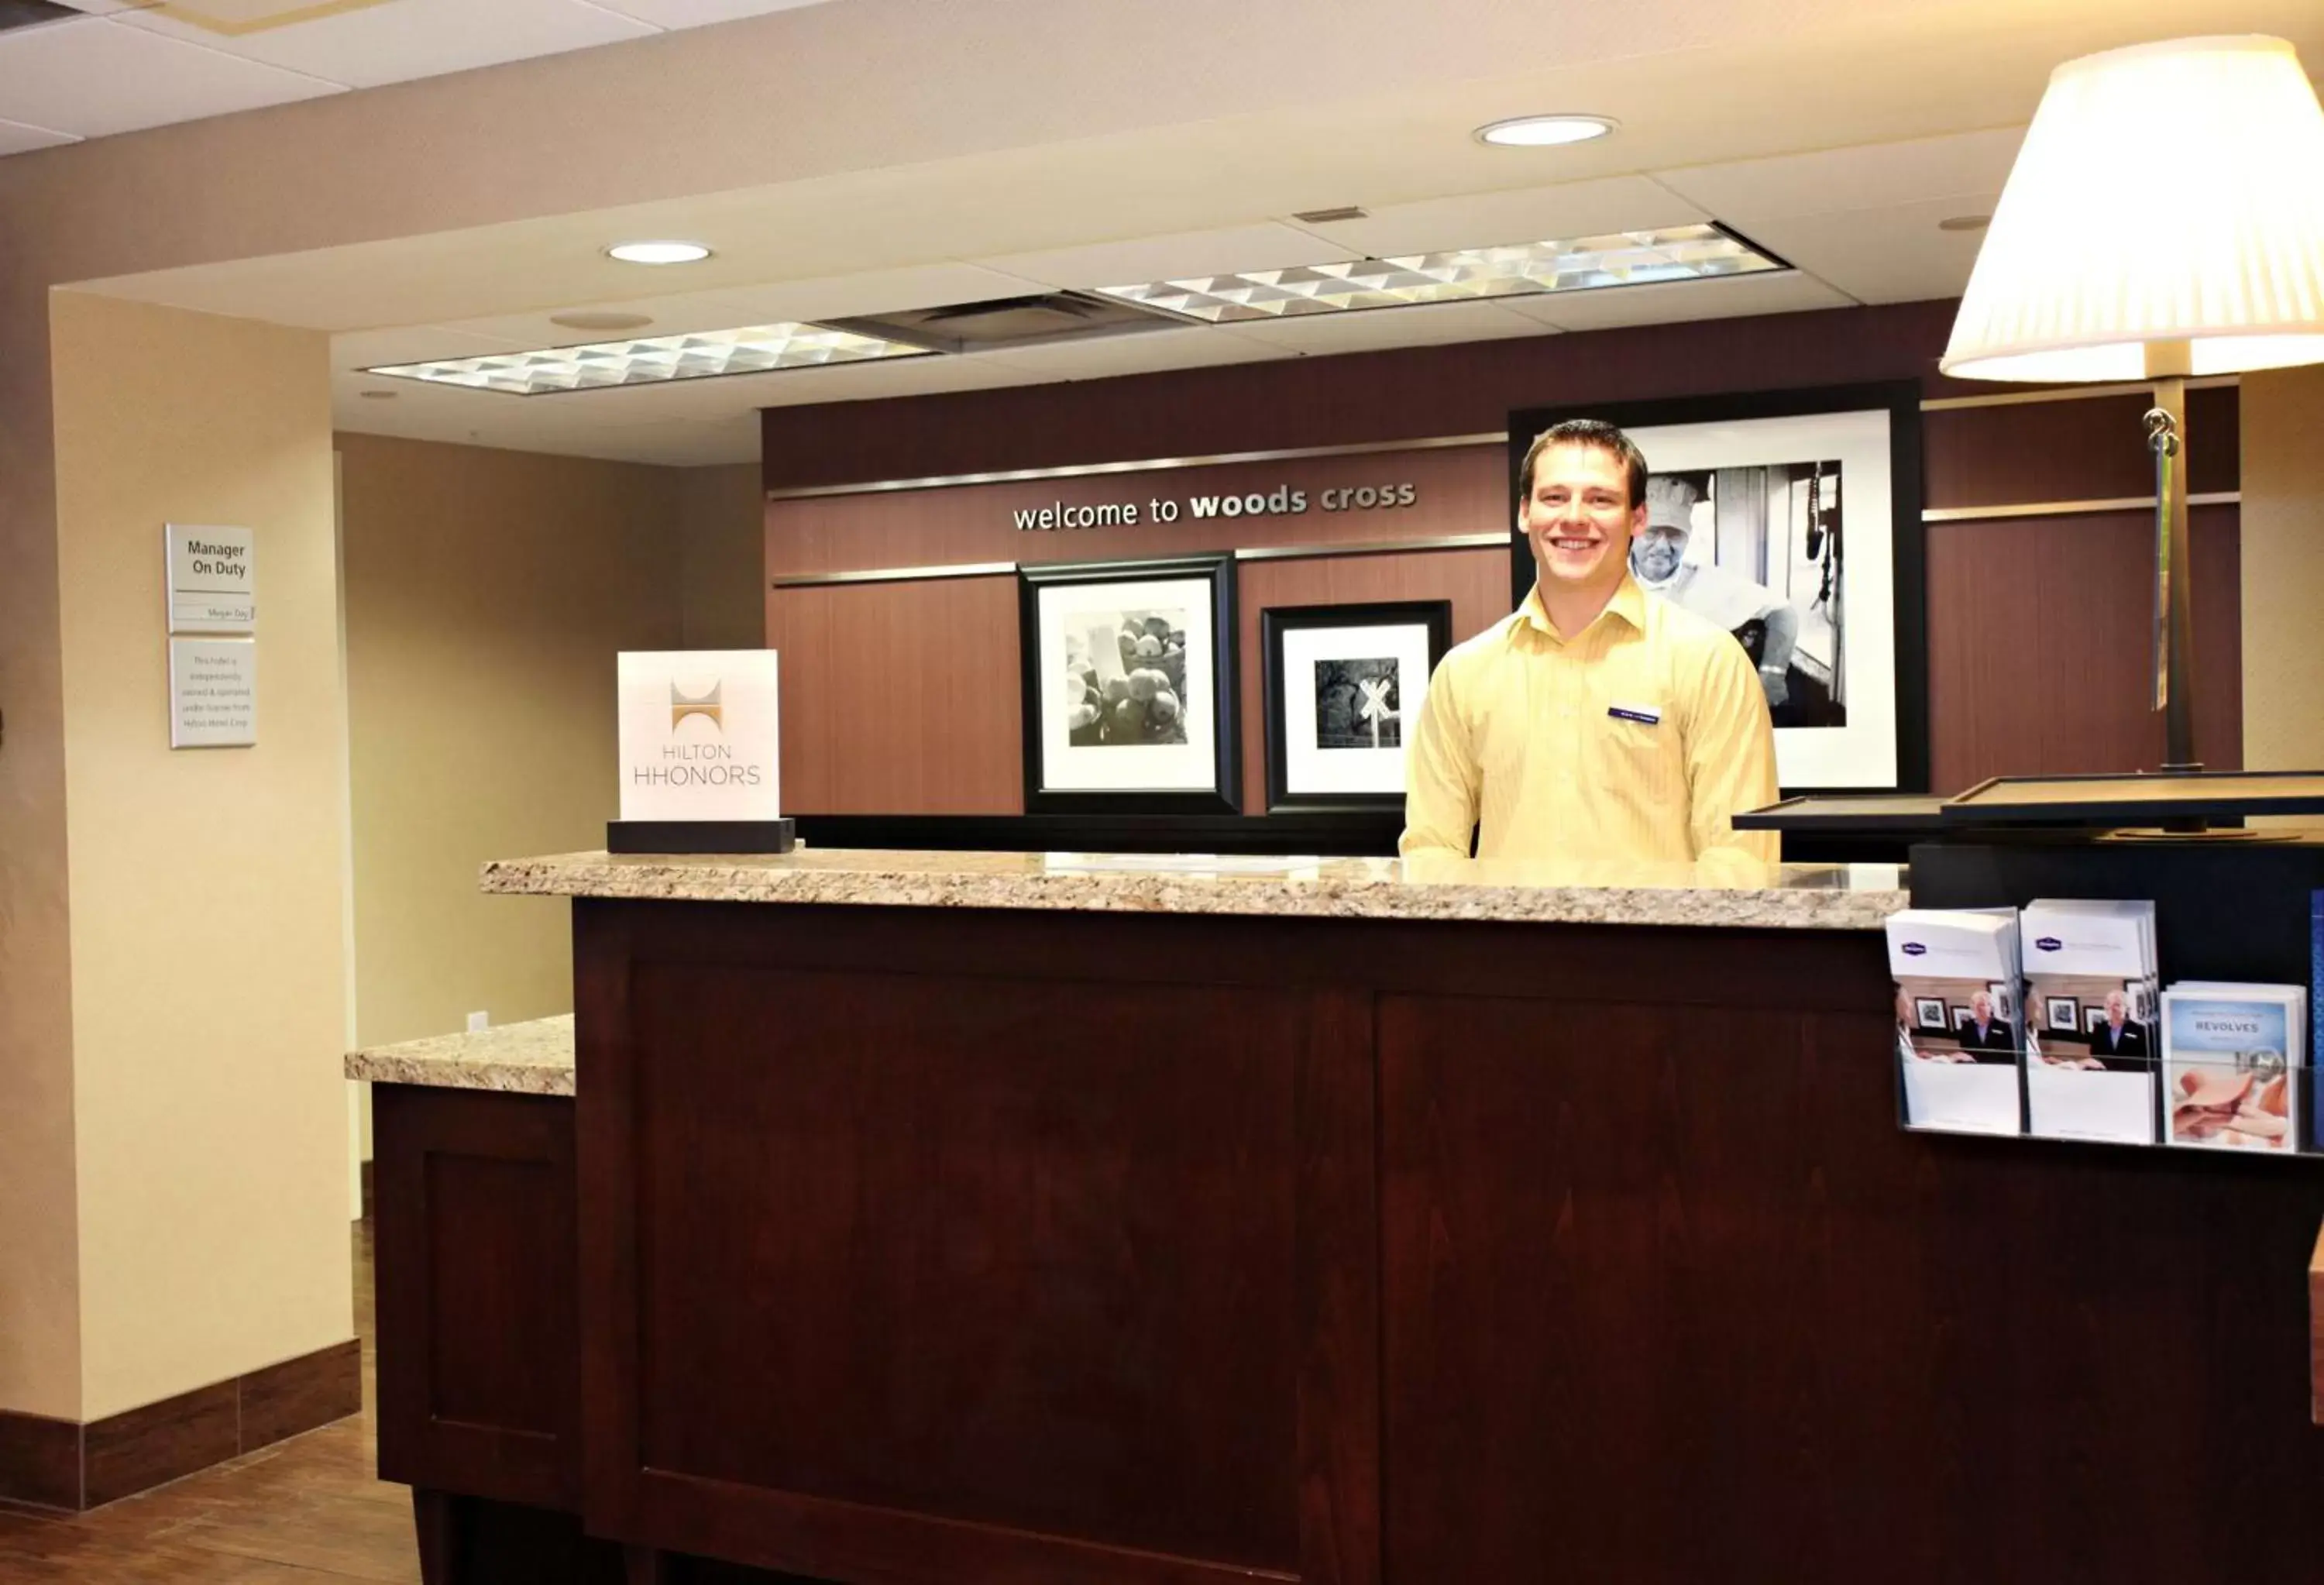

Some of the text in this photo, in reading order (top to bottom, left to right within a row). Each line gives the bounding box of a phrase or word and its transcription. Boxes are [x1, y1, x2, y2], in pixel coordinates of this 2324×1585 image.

[1014, 482, 1416, 530] welcome to woods cross
[187, 540, 245, 559] Manager
[193, 559, 246, 579] On Duty
[662, 744, 731, 760] HILTON
[634, 765, 761, 786] HHONORS
[2195, 1021, 2259, 1033] REVOLVES
